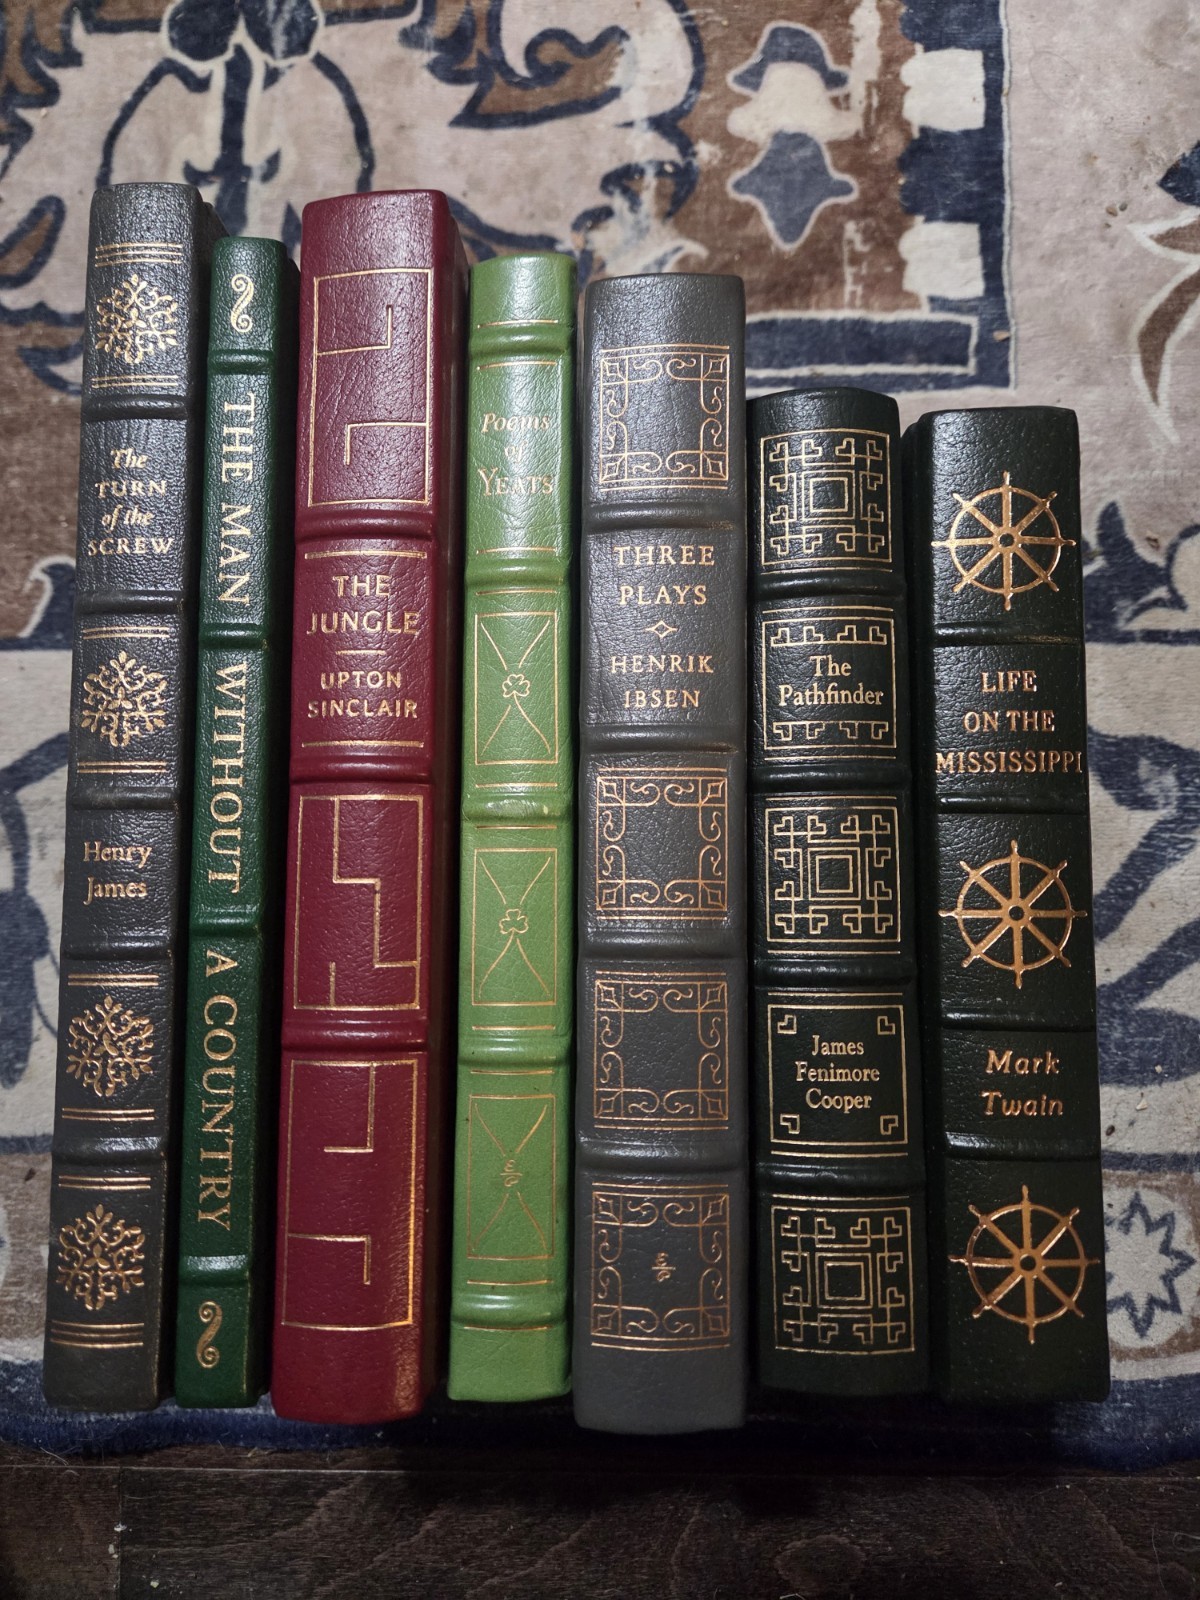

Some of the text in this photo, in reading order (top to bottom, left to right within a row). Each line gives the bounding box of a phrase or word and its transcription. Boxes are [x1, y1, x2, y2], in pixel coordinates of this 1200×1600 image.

[481, 412, 553, 433] Poems
[110, 448, 148, 469] The
[95, 480, 168, 499] TURN
[101, 503, 153, 533] of the
[88, 537, 174, 556] SCREW
[613, 545, 716, 567] THREE
[332, 574, 392, 598] THE
[619, 585, 708, 606] PLAYS
[306, 610, 421, 636] JUNGLE
[610, 654, 715, 674] HENRIK
[809, 654, 852, 678] The
[320, 670, 402, 691] UPTON
[980, 669, 1038, 693] LIFE
[624, 689, 701, 709] IBSEN
[778, 683, 884, 707] Pathfinder
[307, 698, 418, 719] SINCLAIR
[963, 709, 1056, 733] ON THE
[935, 751, 1084, 775] MISSISSIPPI
[197, 391, 256, 1232] THE MAN WITHOUT A COUNTRY
[83, 841, 153, 869] Henry
[83, 876, 149, 906] James
[811, 1034, 865, 1057] James
[794, 1060, 881, 1083] Fenimore
[984, 1049, 1061, 1076] Mark
[805, 1087, 873, 1114] Cooper
[980, 1090, 1064, 1117] Twain
